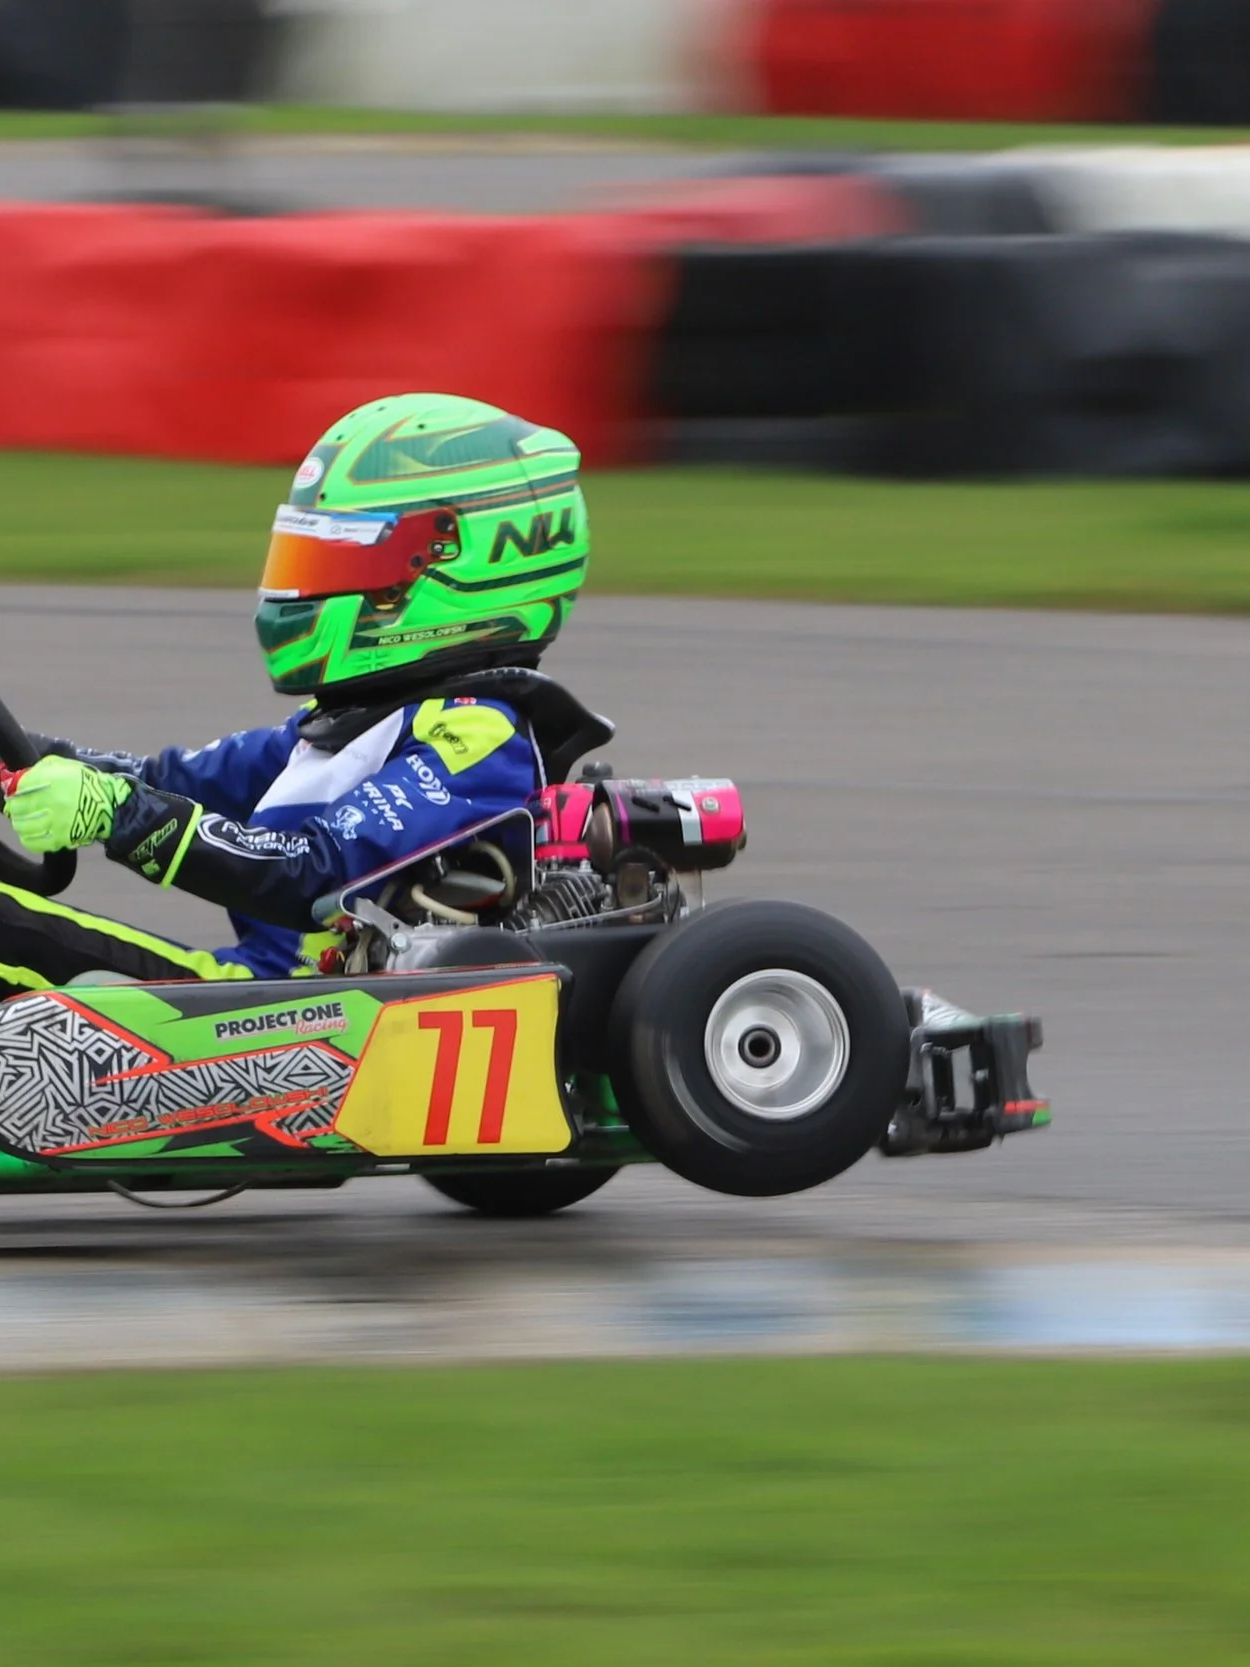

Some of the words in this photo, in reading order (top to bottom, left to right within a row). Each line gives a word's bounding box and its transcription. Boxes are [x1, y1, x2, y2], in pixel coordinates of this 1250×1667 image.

[378, 635, 402, 645] NICO
[214, 1011, 298, 1039] PROJECT
[301, 1002, 343, 1022] ONE
[294, 1019, 348, 1036] Racing
[418, 1009, 517, 1146] 77
[87, 1117, 149, 1138] NICO
